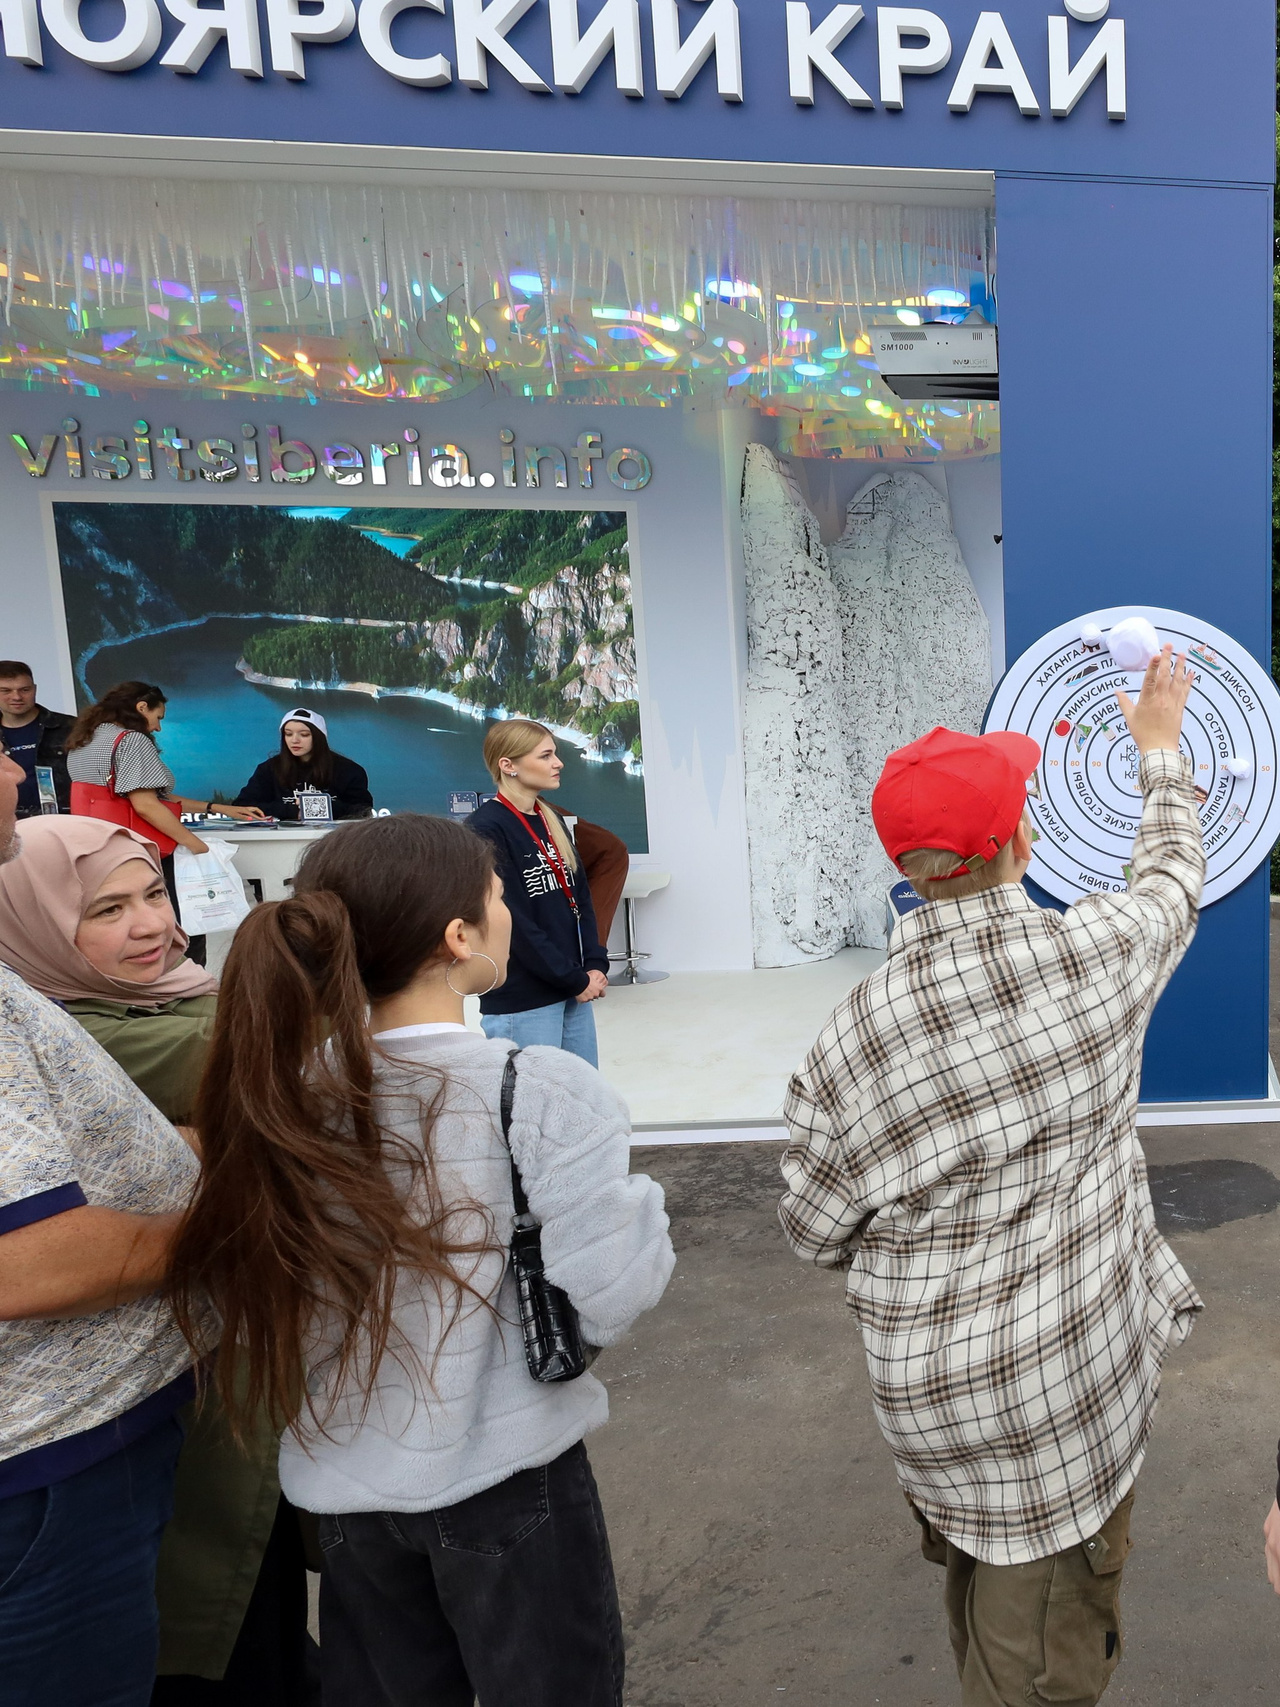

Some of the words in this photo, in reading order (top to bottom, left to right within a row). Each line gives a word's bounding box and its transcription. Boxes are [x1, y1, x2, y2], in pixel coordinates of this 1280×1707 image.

[786, 0, 1127, 120] КРАЙ
[880, 343, 914, 351] SM1000
[8, 416, 653, 491] visitsiberia.info
[1037, 649, 1081, 687] ХАТАНГА
[1065, 676, 1129, 720] МИНУСИНСК
[1220, 670, 1256, 712] ДИКСОН
[1205, 712, 1229, 759] ОСТРОВ
[1073, 771, 1103, 817] СТОЛБЫ
[1038, 803, 1069, 843] ЕРГАКИ
[1203, 824, 1228, 851] ЕНИС
[1079, 872, 1110, 891] ВИВИ
